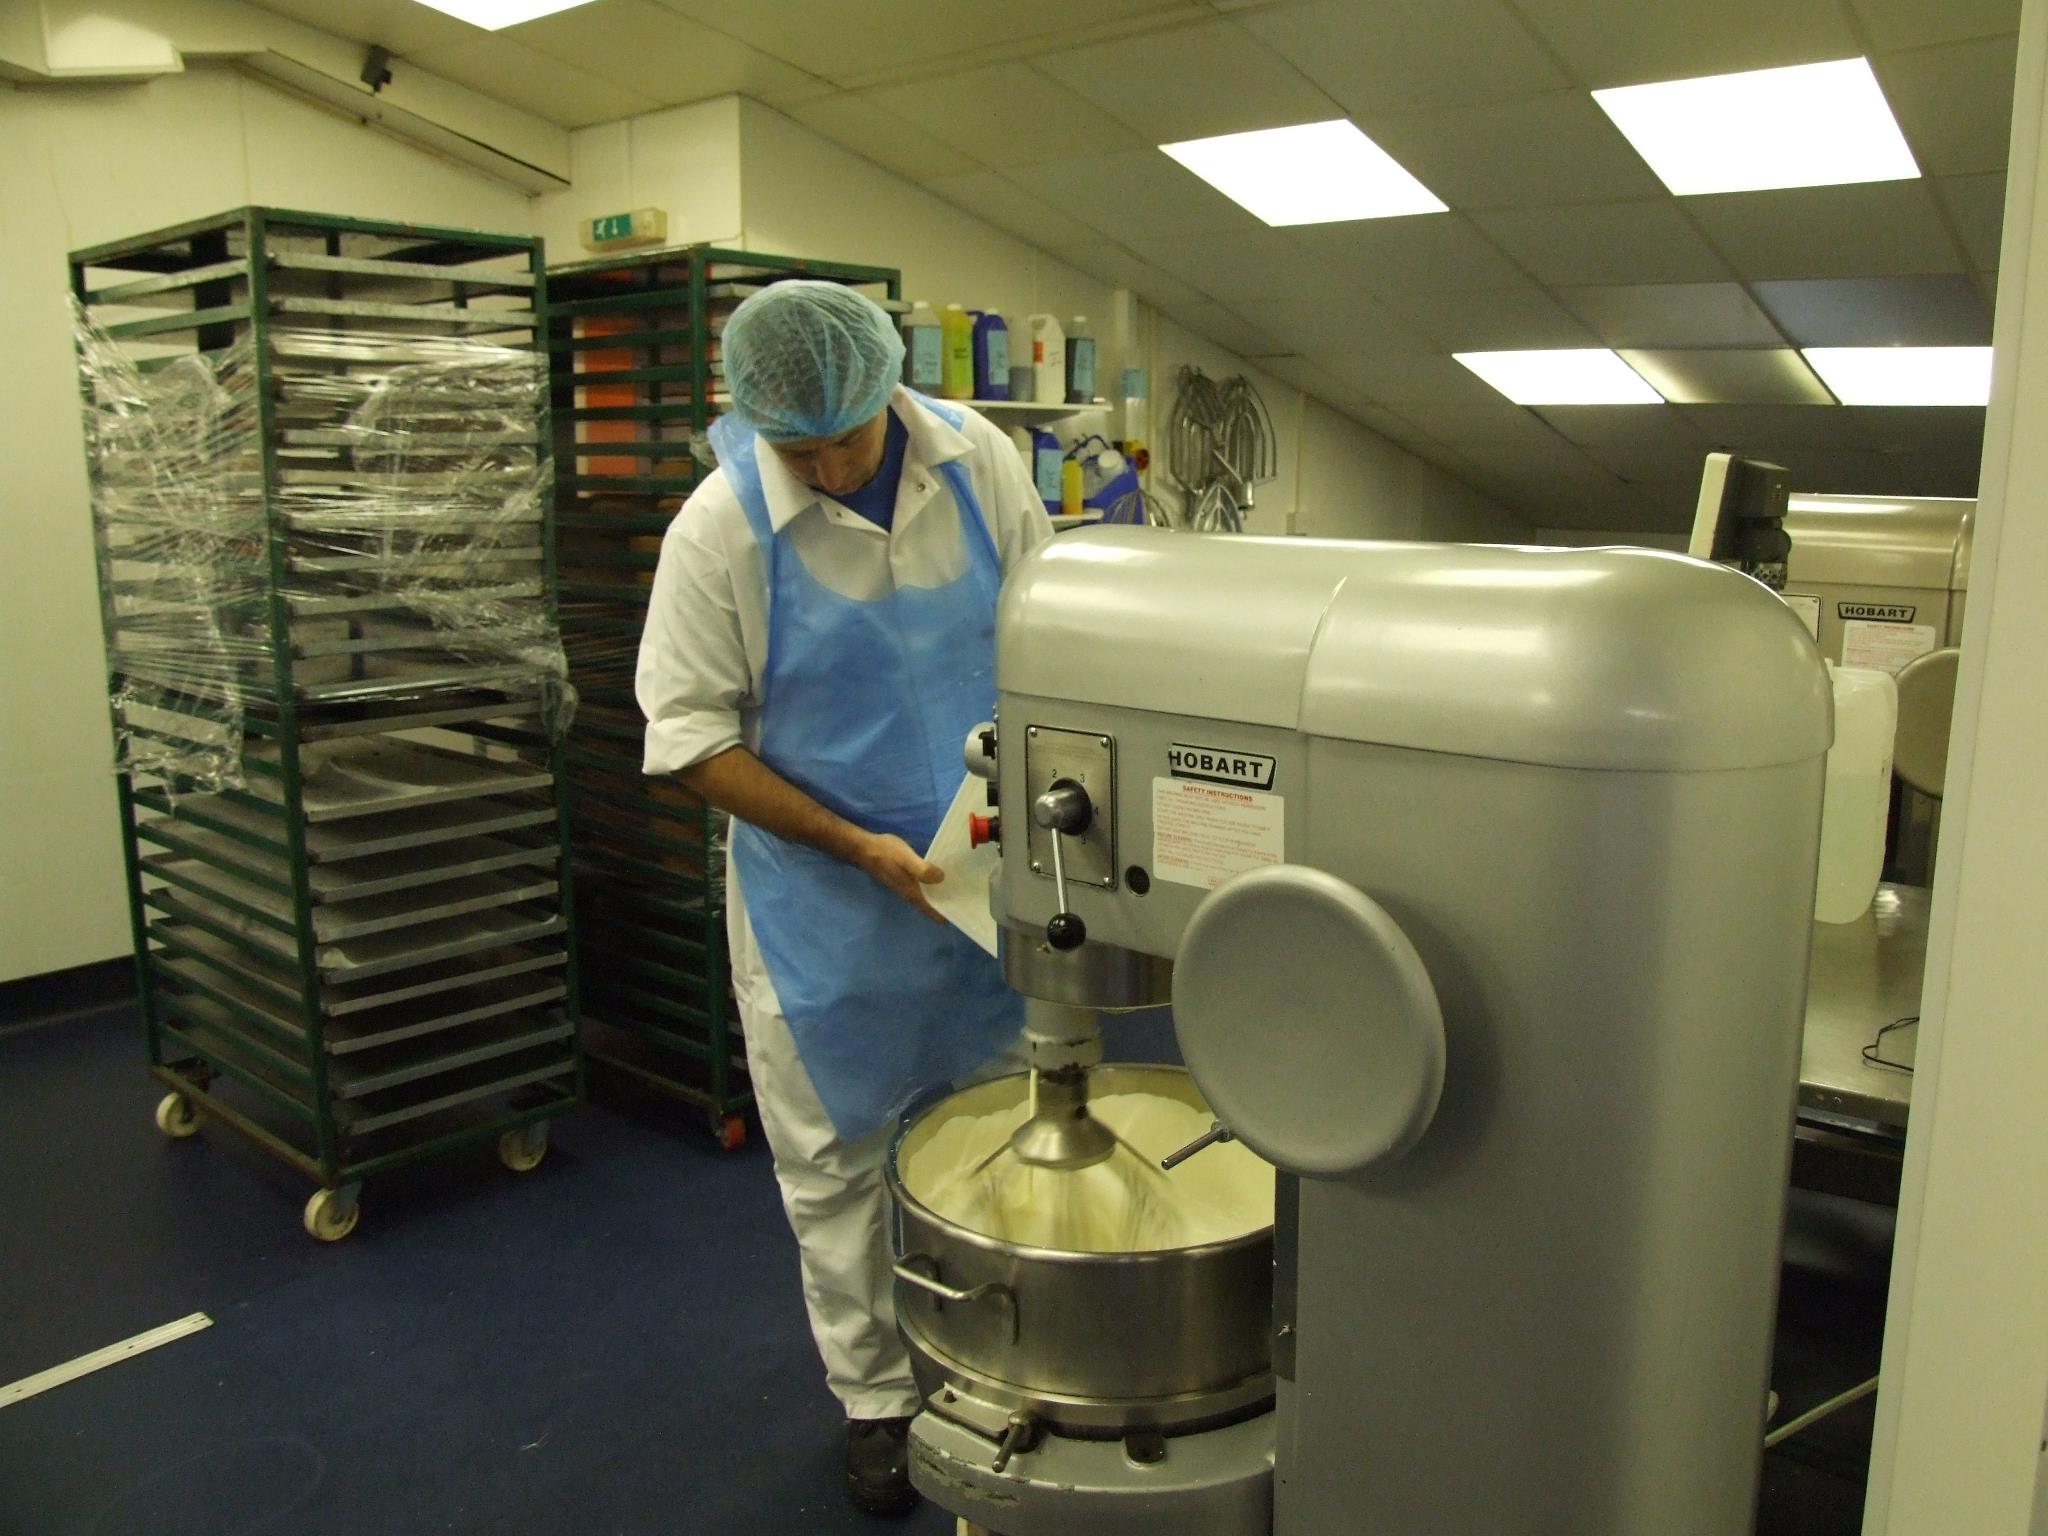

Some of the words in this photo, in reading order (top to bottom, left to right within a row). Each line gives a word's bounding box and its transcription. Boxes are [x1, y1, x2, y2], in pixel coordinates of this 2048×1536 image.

[1845, 607, 1908, 618] HOBART
[1168, 750, 1263, 778] HOBART
[1183, 785, 1206, 795] SAFETY
[1206, 789, 1254, 802] INSTRUCTIONS
